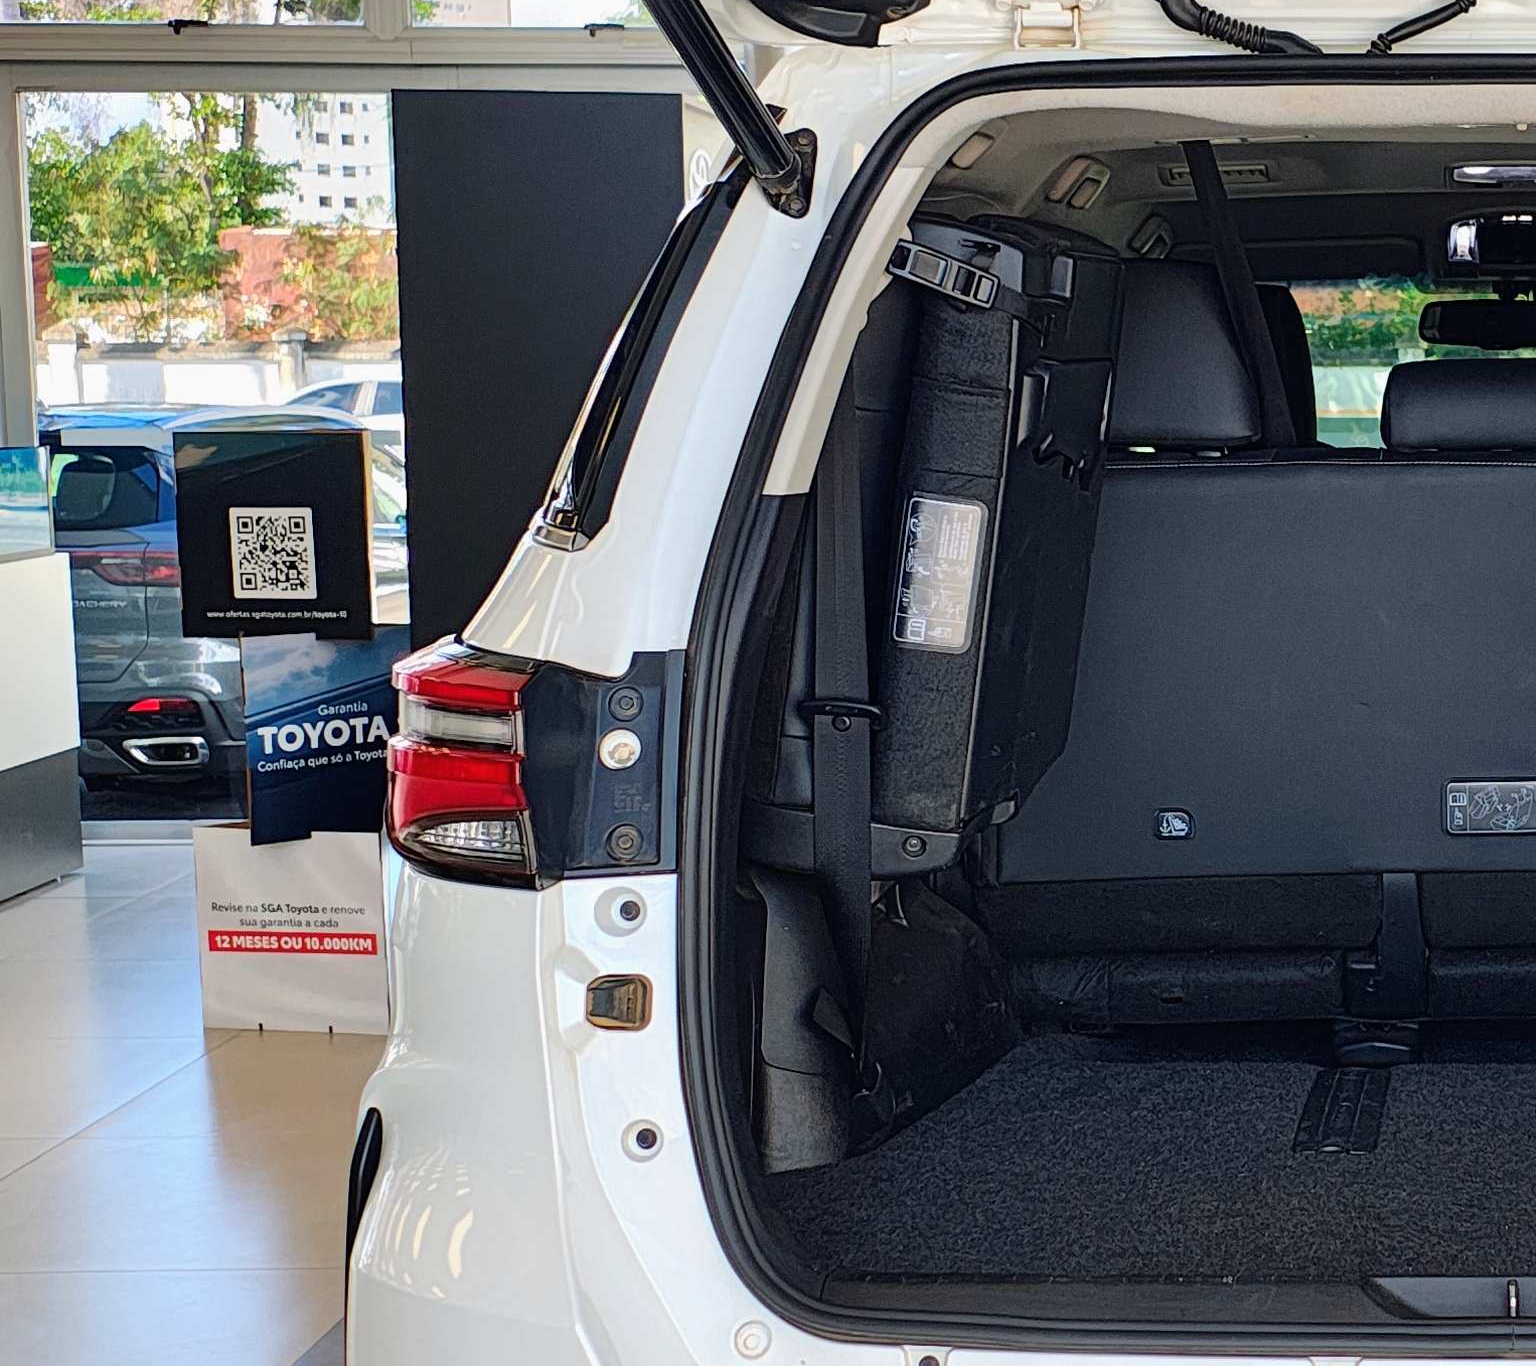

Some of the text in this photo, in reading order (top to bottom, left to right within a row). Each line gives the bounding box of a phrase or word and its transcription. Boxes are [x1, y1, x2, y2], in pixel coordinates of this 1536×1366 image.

[317, 701, 368, 716] Garantia
[257, 715, 391, 755] TOYOTA
[308, 755, 329, 768] que
[330, 753, 344, 763] só
[346, 753, 352, 761] a
[211, 902, 243, 913] Revise
[245, 904, 258, 913] na
[261, 904, 283, 913] SGA
[286, 904, 320, 915] Toyota
[330, 907, 366, 915] renove
[239, 918, 257, 927] sua
[260, 917, 302, 928] garantia
[313, 918, 339, 928] cada
[215, 935, 373, 951] 12 MESES OU 10.000KM
